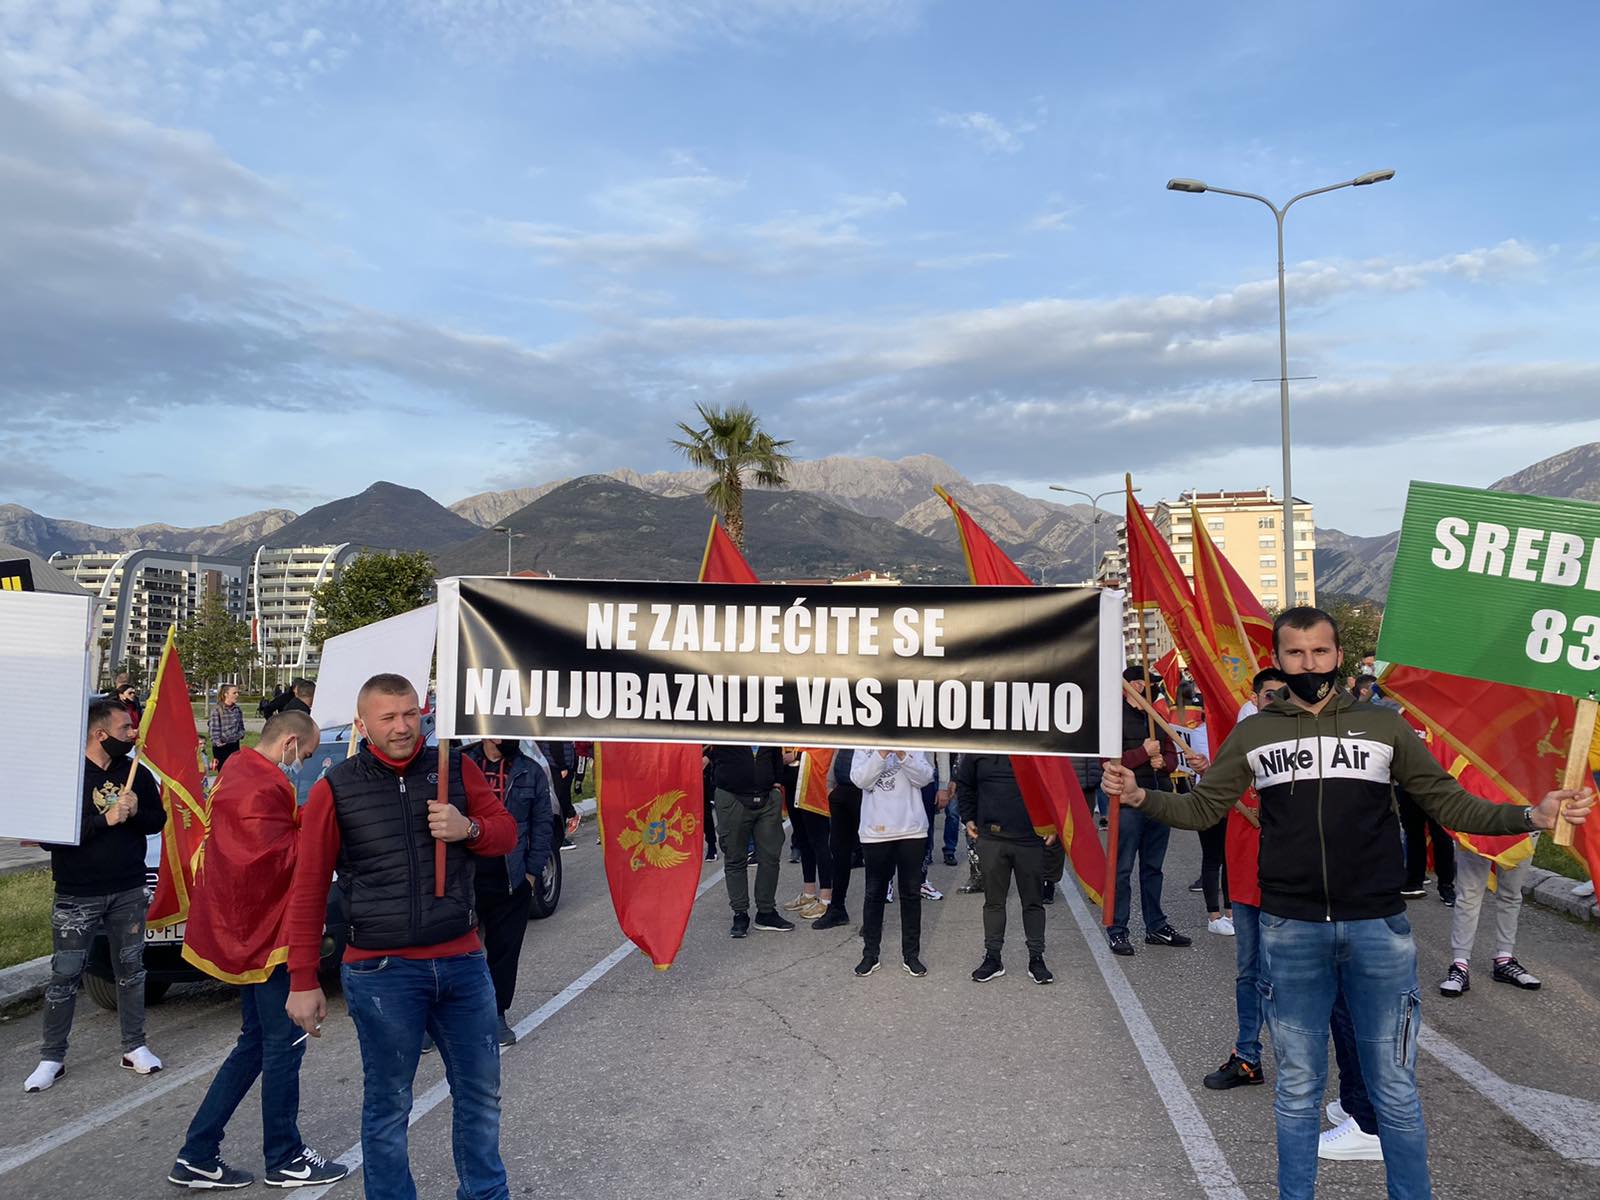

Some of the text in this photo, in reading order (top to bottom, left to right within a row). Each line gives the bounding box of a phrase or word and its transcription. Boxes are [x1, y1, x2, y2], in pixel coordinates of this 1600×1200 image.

[1431, 516, 1600, 591] SREB
[586, 597, 945, 657] NE ZALIJEĆITE SE
[1525, 608, 1600, 671] 83
[464, 668, 1084, 733] NAJLJUBAZNIJE VAS MOLIMO
[1259, 744, 1370, 777] Nike Air
